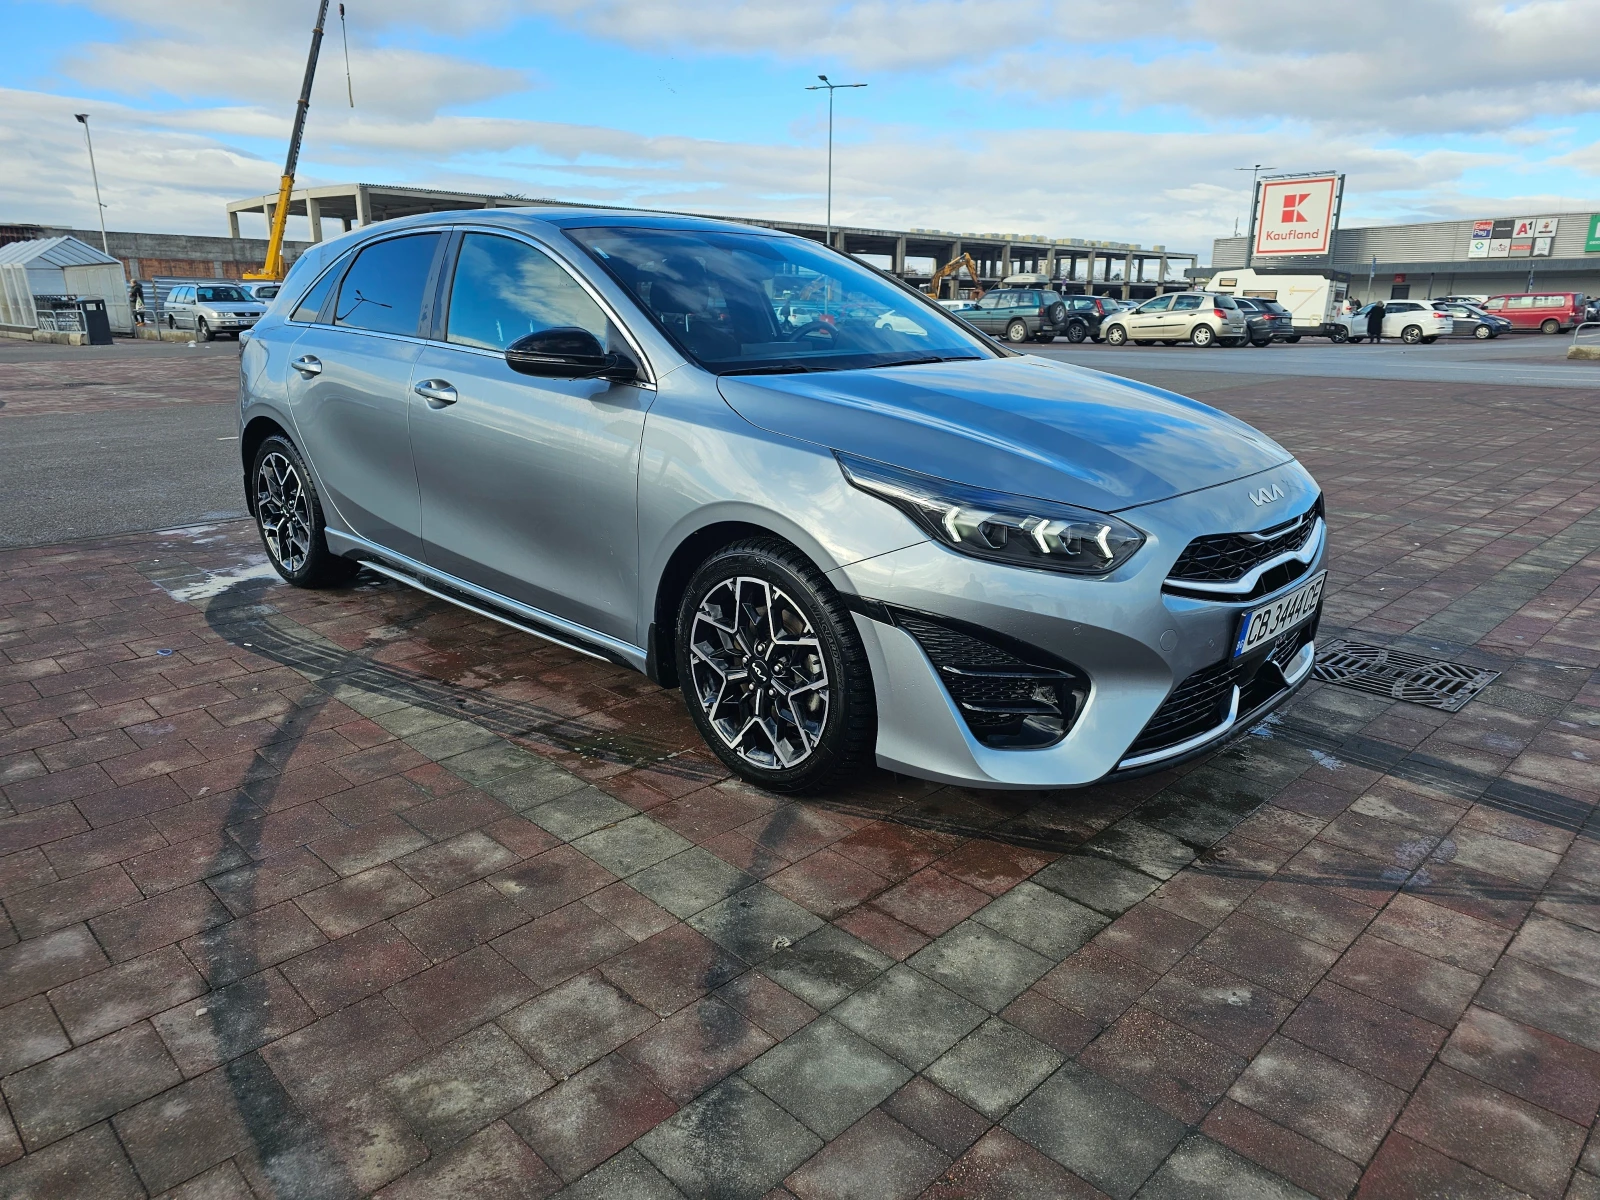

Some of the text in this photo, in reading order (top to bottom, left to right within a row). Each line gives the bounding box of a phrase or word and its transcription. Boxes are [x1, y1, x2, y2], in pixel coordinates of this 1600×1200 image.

[1475, 223, 1493, 231] Easy
[1516, 221, 1533, 236] A1
[1266, 229, 1320, 241] Kaufland
[1474, 229, 1487, 237] Pay
